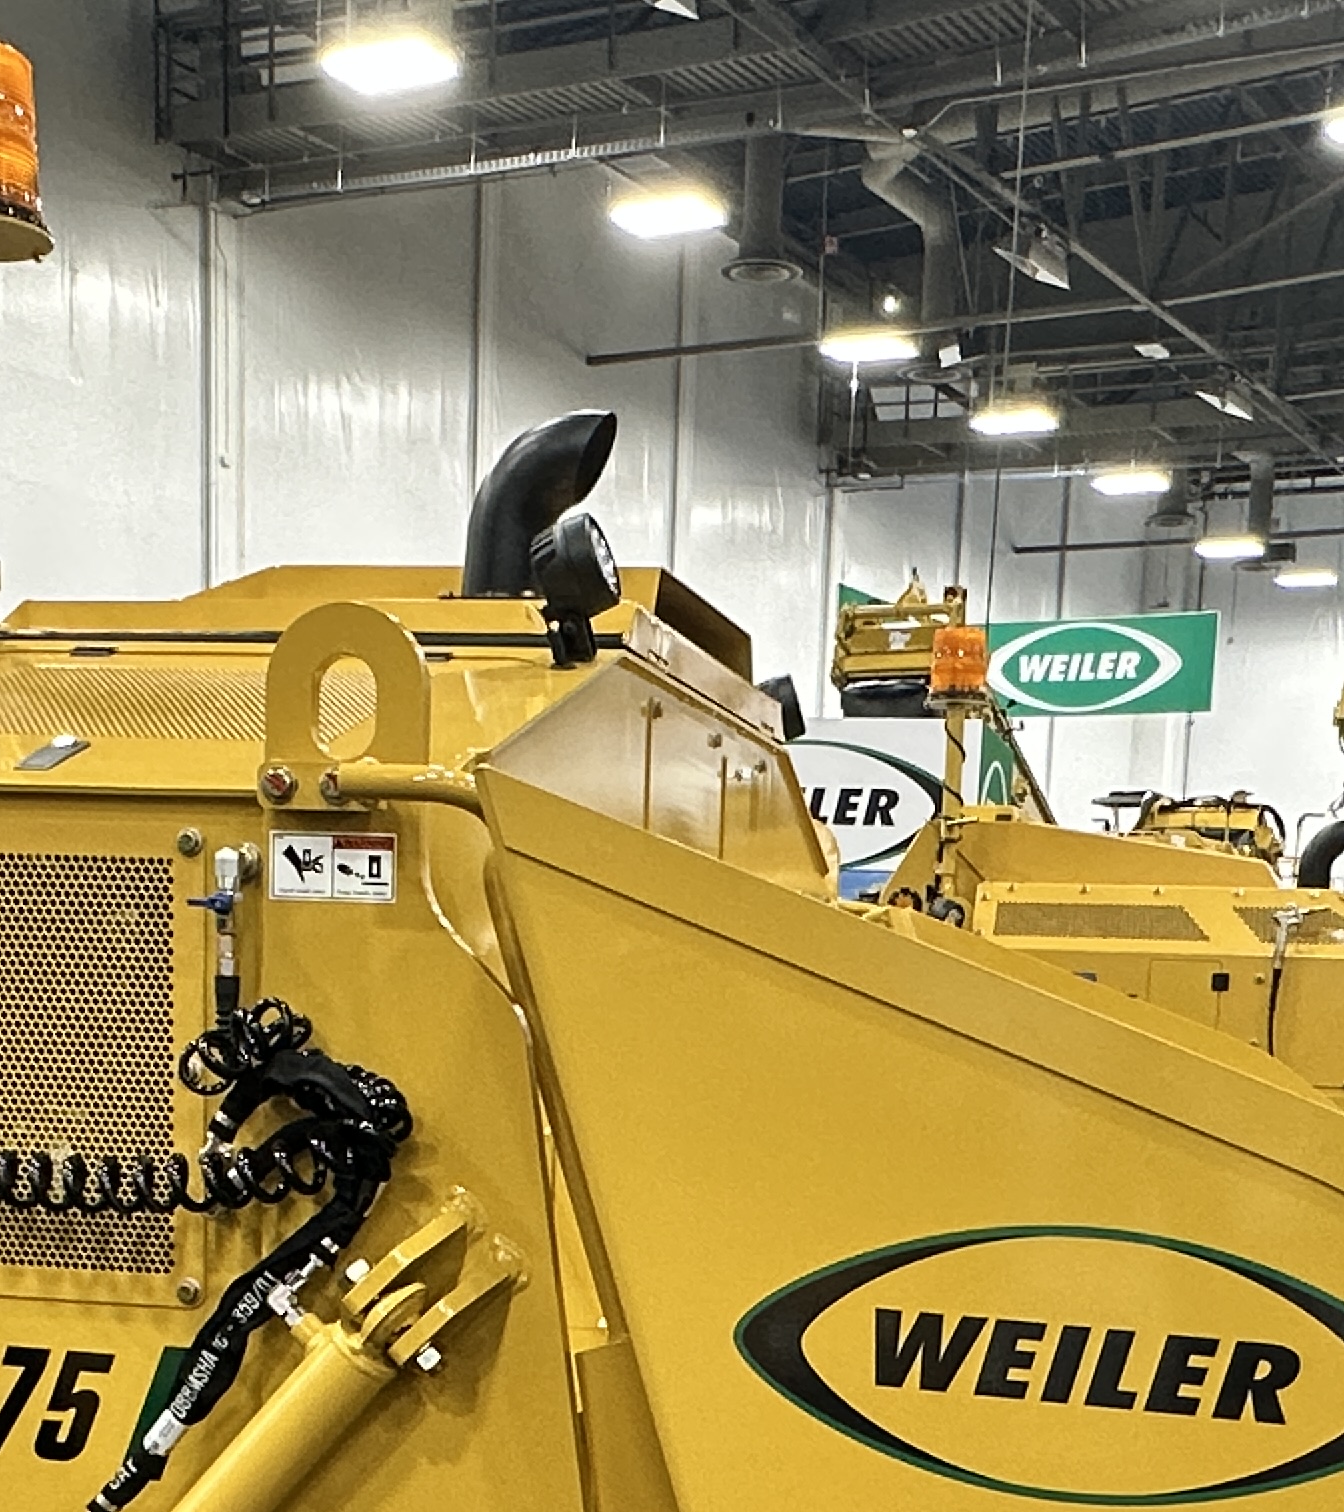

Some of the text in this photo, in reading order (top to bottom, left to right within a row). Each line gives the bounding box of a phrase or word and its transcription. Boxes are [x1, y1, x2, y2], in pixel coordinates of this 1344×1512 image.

[1018, 651, 1141, 683] WEILER
[802, 787, 900, 826] LER
[873, 1307, 1302, 1426] WEILER
